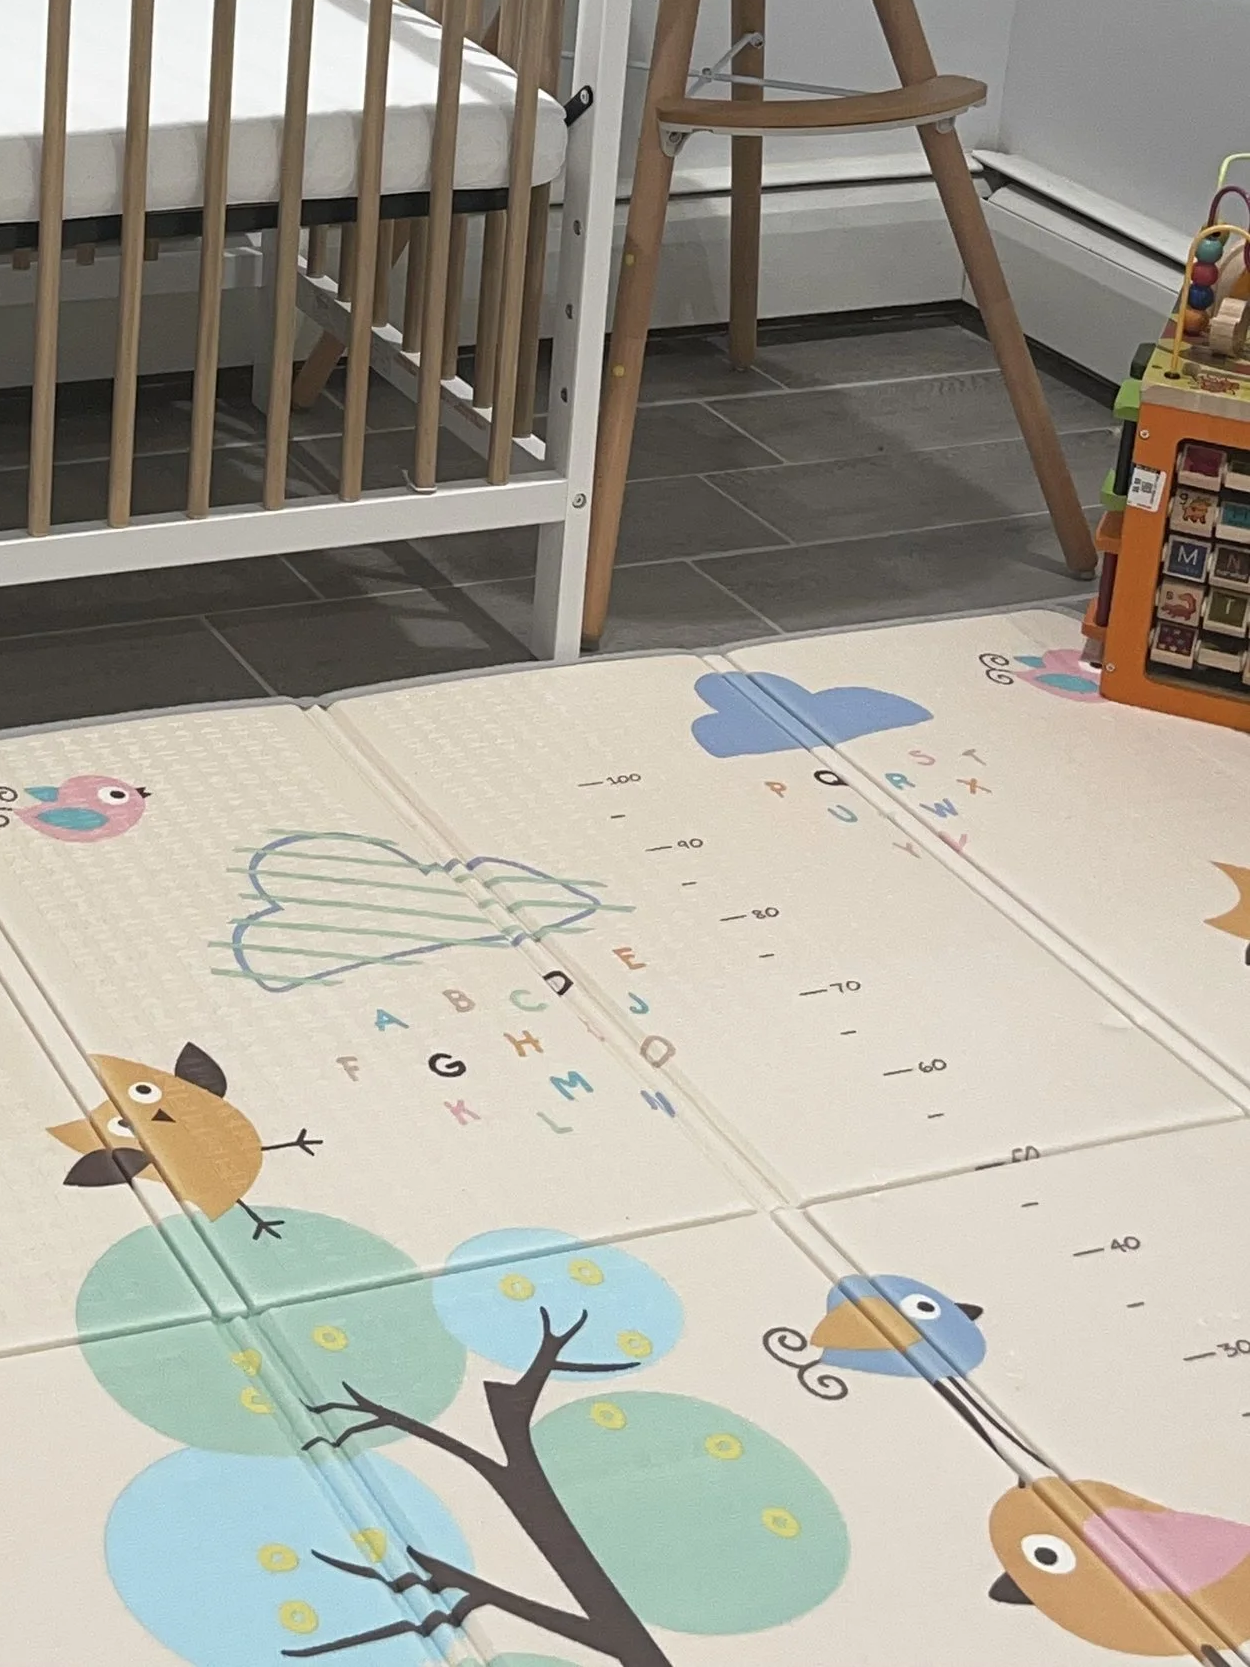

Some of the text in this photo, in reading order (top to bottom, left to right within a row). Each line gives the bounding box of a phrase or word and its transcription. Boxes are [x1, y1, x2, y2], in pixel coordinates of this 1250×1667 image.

[1177, 545, 1199, 565] M
[605, 773, 641, 786] 100
[765, 749, 987, 798] P Q R S T
[937, 772, 962, 784] baby
[827, 805, 858, 822] U
[919, 798, 958, 818] W
[677, 838, 704, 849] 90
[752, 907, 780, 919] 80
[374, 1009, 409, 1031] A
[442, 990, 475, 1013] B
[509, 990, 547, 1012] C
[613, 947, 645, 970] E
[829, 980, 861, 993] 70
[336, 992, 649, 1082] F G H J
[918, 1058, 947, 1074] 60
[443, 1099, 481, 1125] K
[550, 1071, 594, 1100] M
[640, 1036, 675, 1068] O
[1110, 1235, 1141, 1253] 40
[1216, 1339, 1250, 1358] 30
